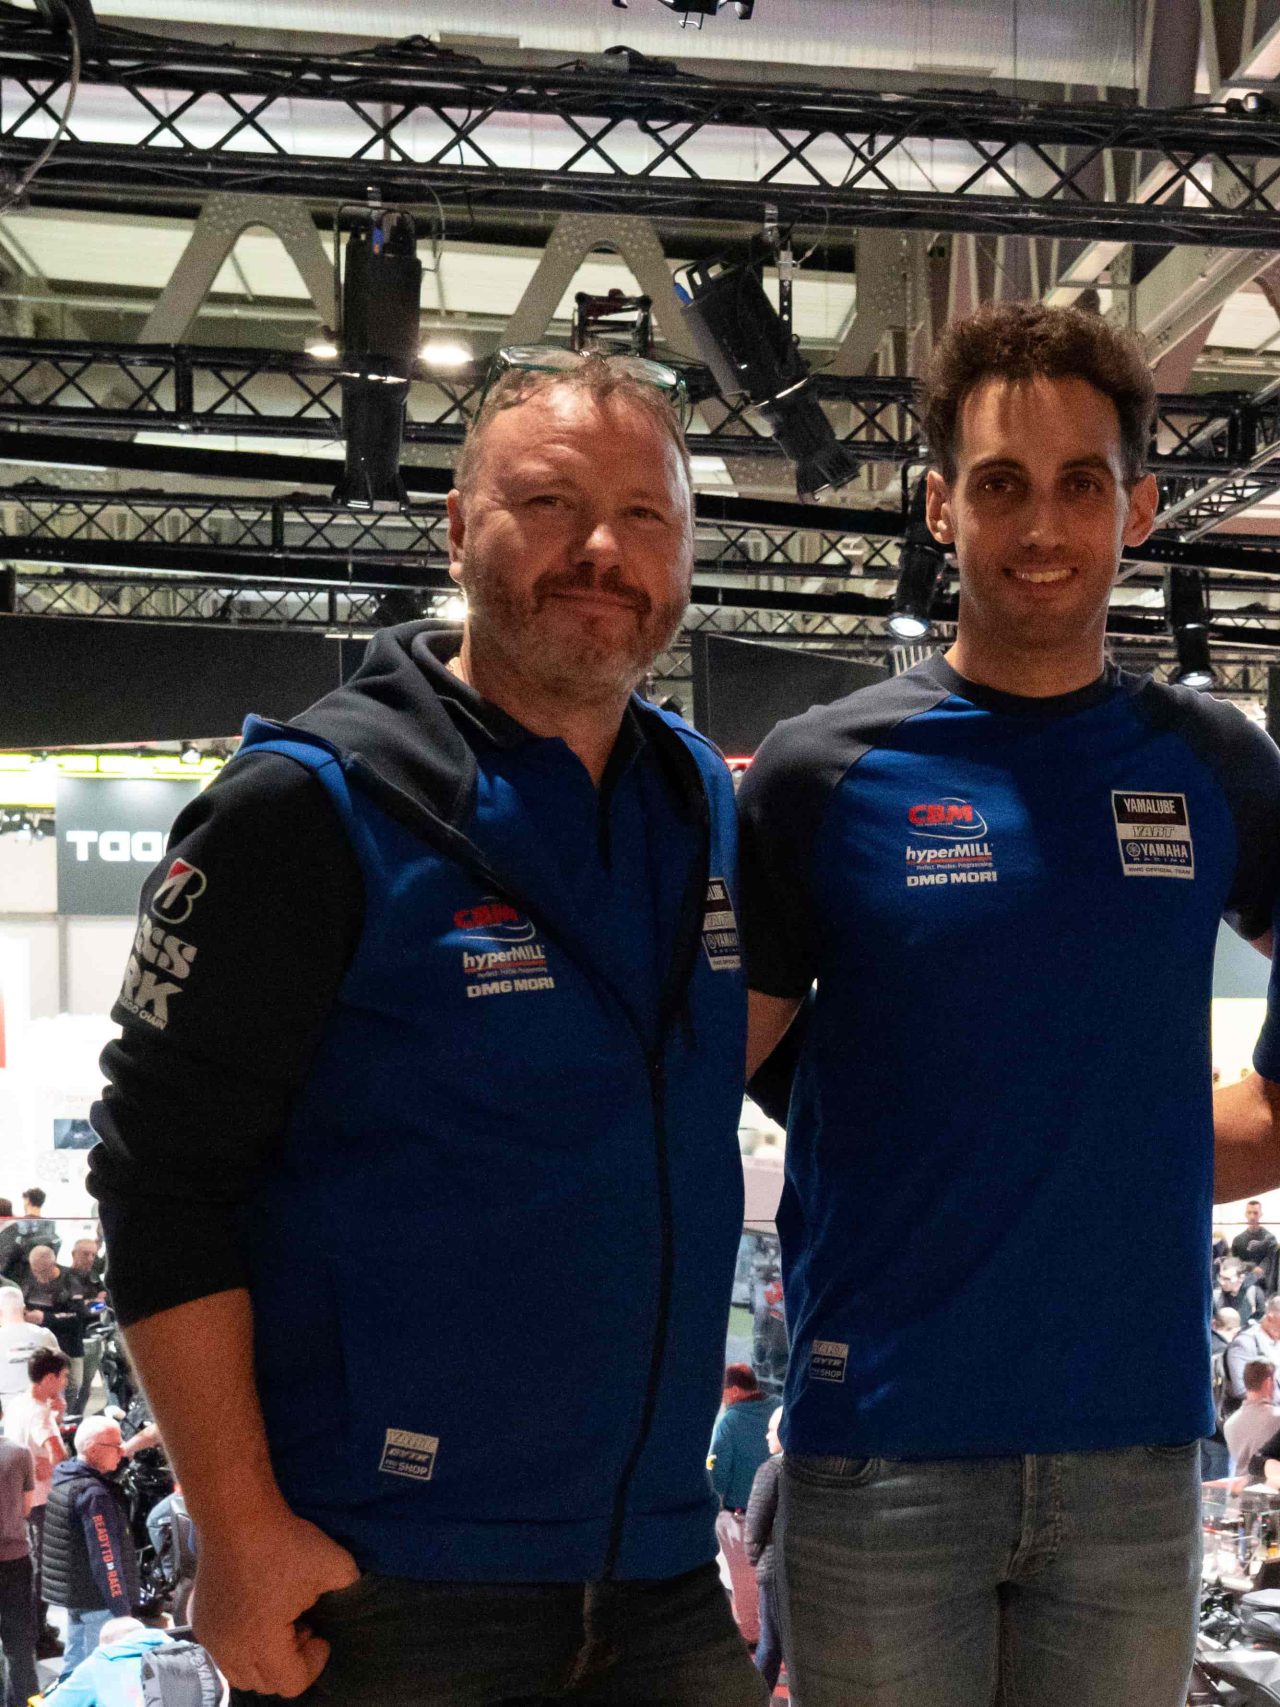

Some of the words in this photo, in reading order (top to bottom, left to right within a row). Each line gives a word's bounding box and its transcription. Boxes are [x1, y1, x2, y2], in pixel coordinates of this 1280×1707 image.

[1124, 798, 1176, 814] YAMALUBE
[906, 843, 992, 863] hyperMILL
[1140, 843, 1188, 858] YAMAHA
[906, 873, 948, 887] DMG
[950, 871, 998, 884] MORI
[463, 945, 546, 971] hyperMILL
[466, 980, 513, 998] DMG
[513, 977, 555, 992] MORI
